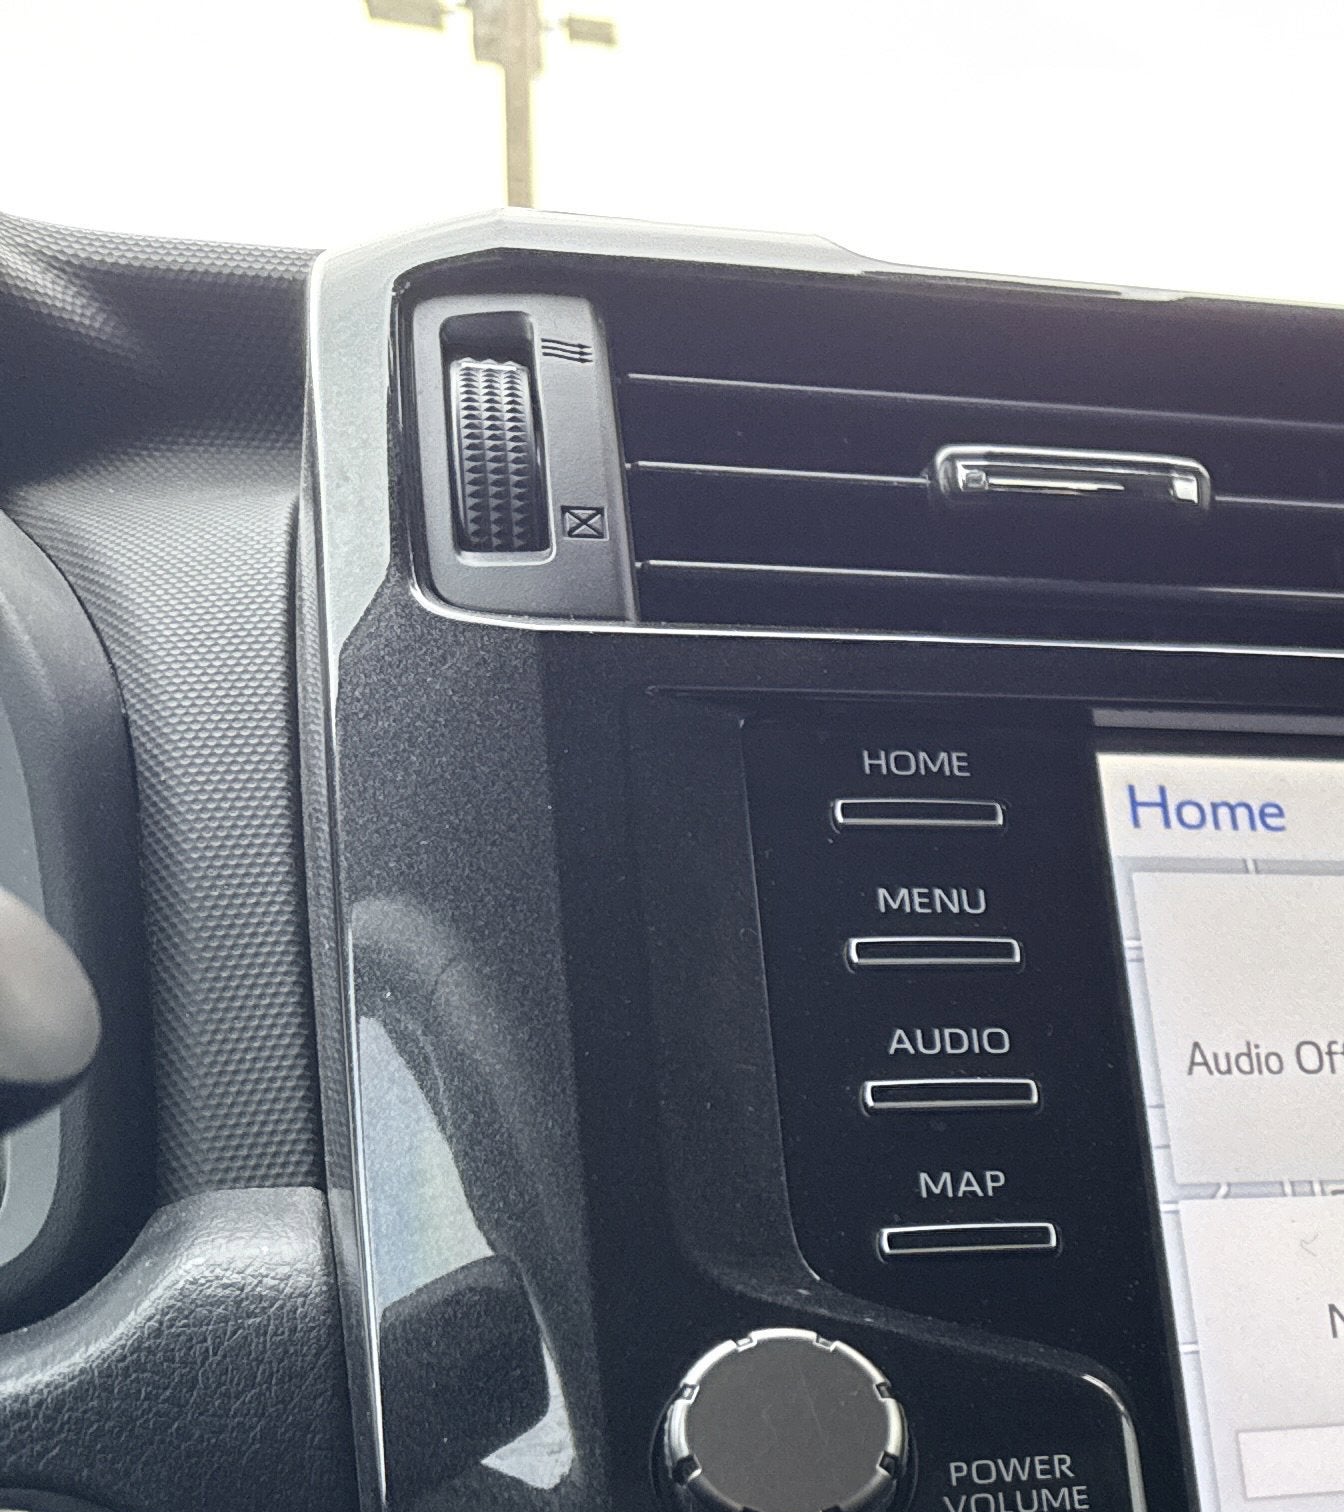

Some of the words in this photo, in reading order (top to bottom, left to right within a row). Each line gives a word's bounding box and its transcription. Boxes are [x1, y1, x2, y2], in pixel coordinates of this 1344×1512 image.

[862, 750, 971, 776] HOME
[1126, 784, 1287, 832] Home
[877, 888, 987, 914] MENU
[888, 1028, 1011, 1054] AUDIO
[1187, 1041, 1285, 1077] Audio
[919, 1171, 1006, 1198] MAP
[949, 1453, 1076, 1487] POWER
